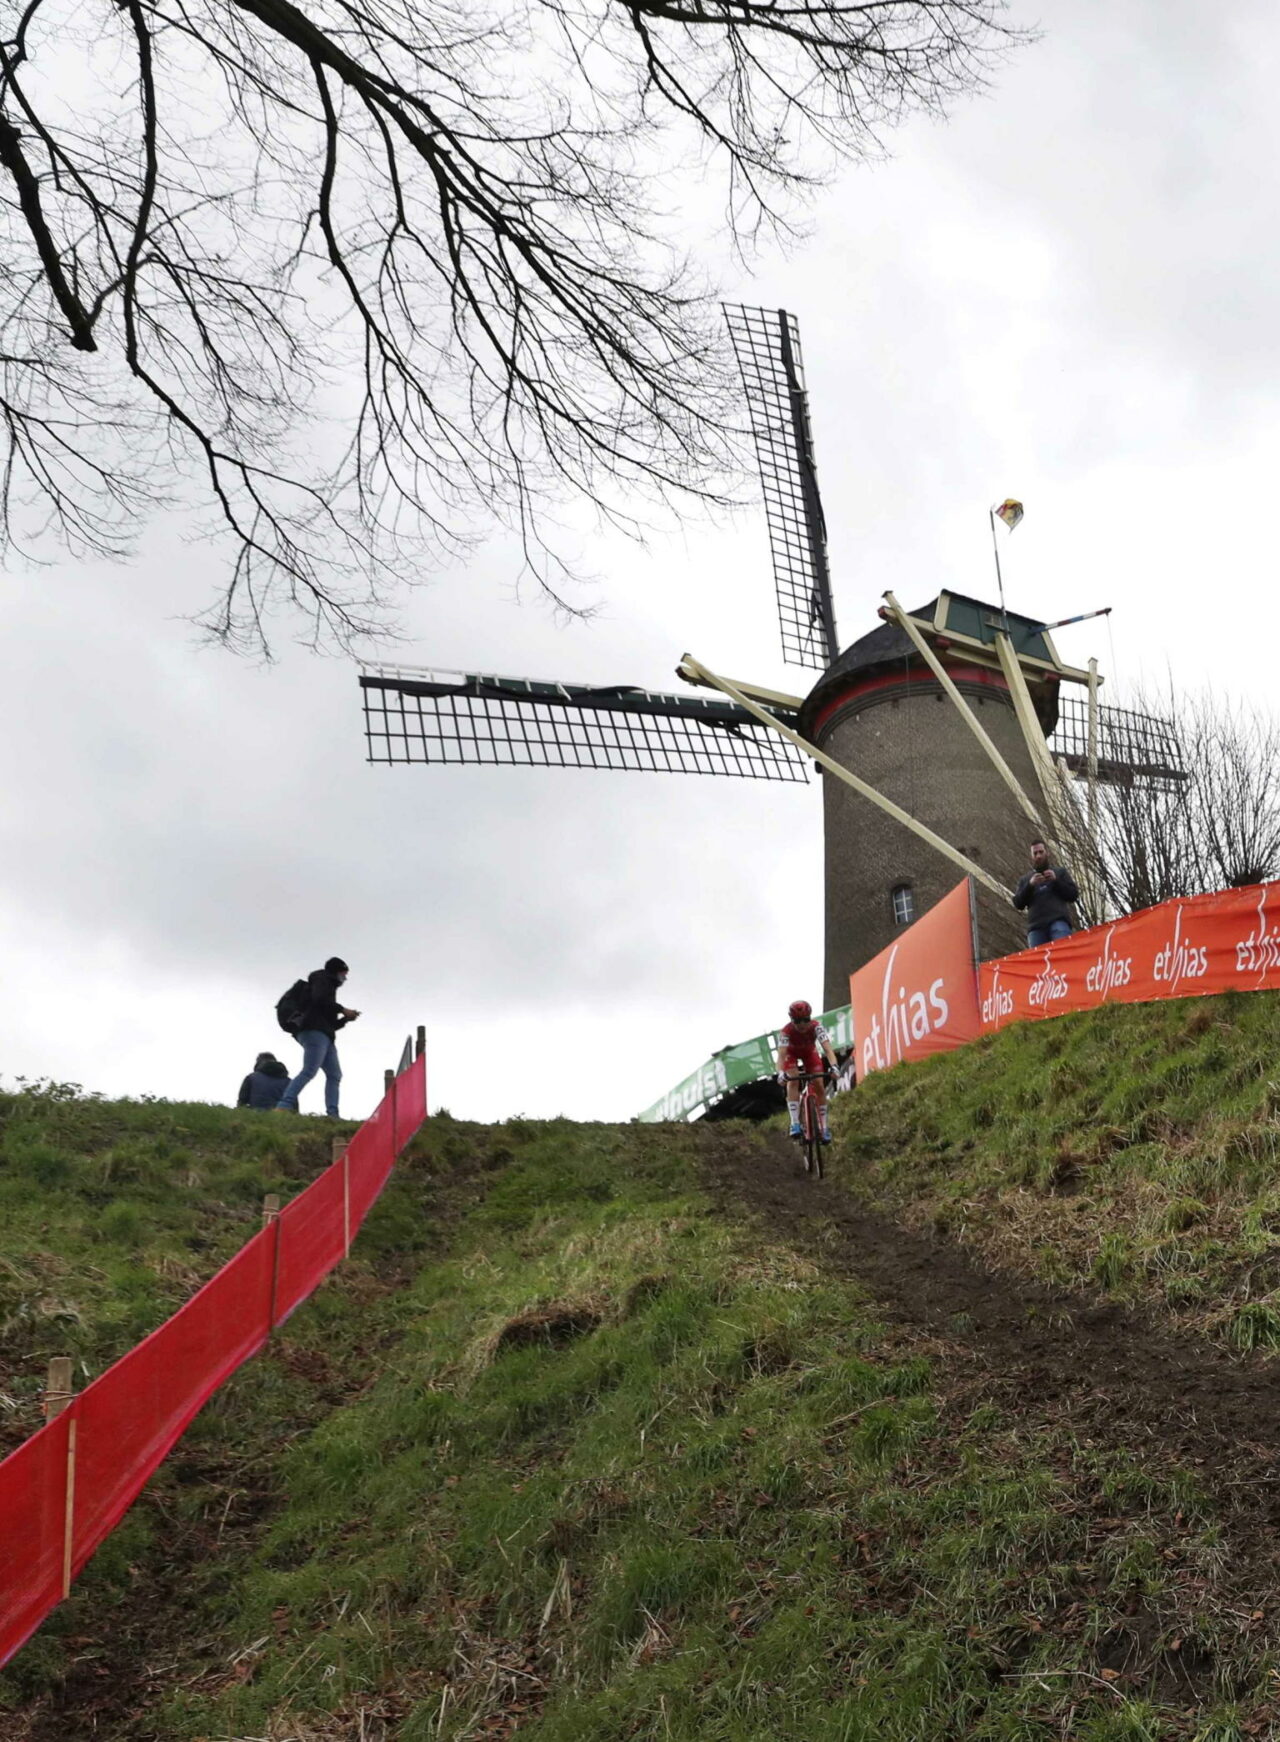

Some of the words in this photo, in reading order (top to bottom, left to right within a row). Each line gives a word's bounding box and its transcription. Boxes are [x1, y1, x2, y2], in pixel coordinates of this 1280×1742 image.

[1029, 948, 1069, 1011] ethias
[1086, 923, 1132, 1000] ethias
[1153, 903, 1208, 993] ethias
[862, 944, 949, 1075] ethias
[982, 965, 1014, 1029] ethias
